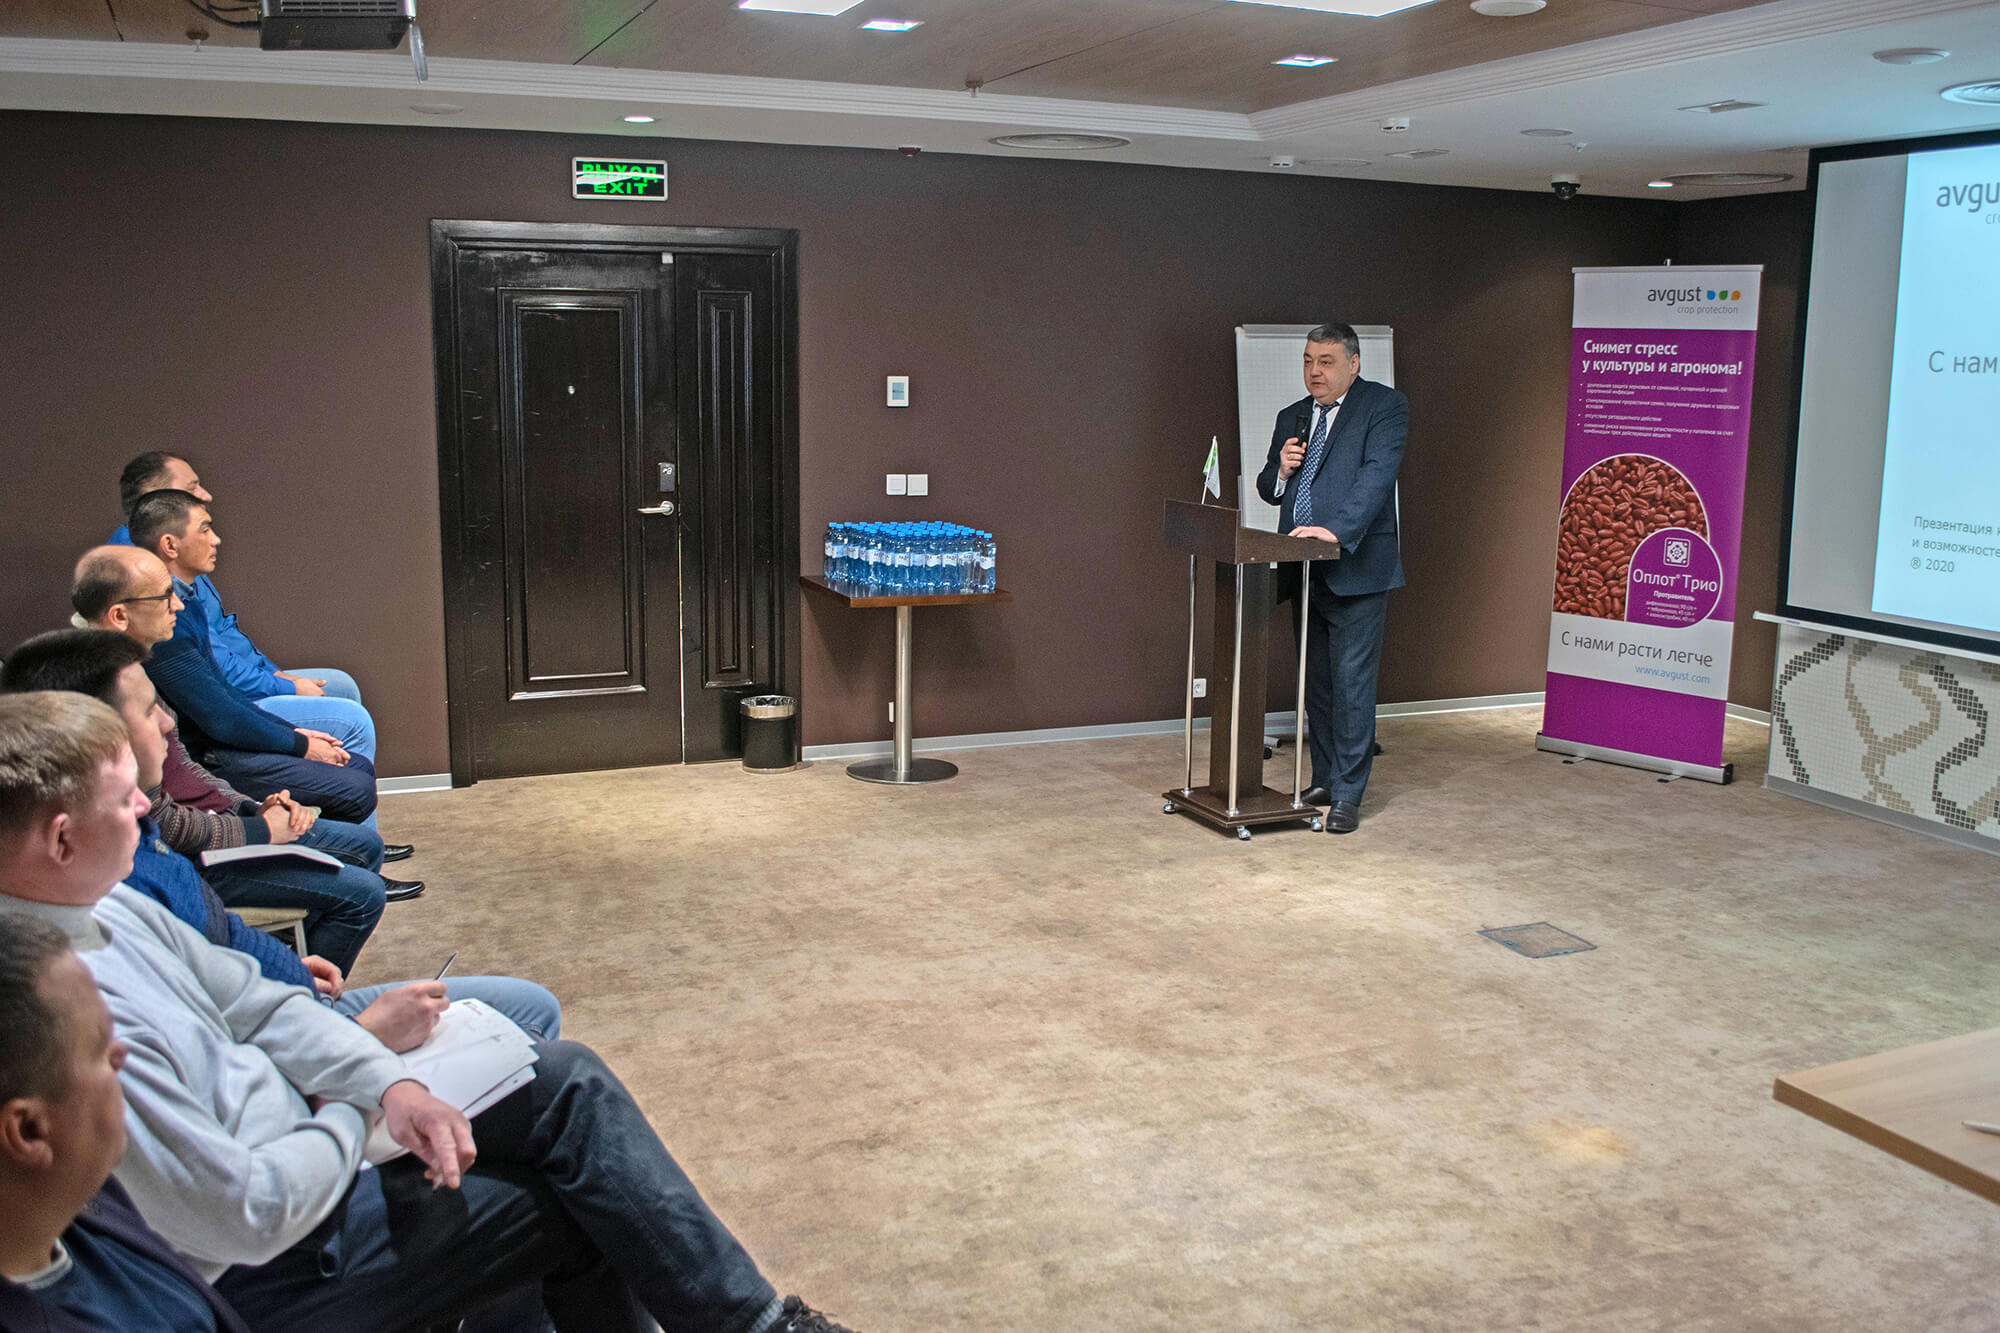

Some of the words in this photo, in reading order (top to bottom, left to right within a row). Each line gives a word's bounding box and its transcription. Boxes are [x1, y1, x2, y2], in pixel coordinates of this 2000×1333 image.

[593, 181, 648, 195] EXIT
[1936, 182, 2000, 213] avgu
[1647, 286, 1701, 306] avgust
[1677, 306, 1694, 314] crop
[1696, 305, 1738, 314] protection
[1583, 340, 1632, 355] Снимет
[1635, 343, 1678, 357] стресс
[1582, 361, 1590, 374] у
[1593, 361, 1654, 375] культуры
[1658, 362, 1667, 372] и
[1670, 361, 1742, 376] агронома!
[1914, 515, 1992, 535] Презентация
[1912, 539, 1919, 548] и
[1925, 558, 1955, 573] 2020
[1682, 574, 1717, 592] Трио
[1561, 631, 1570, 646] С
[1574, 635, 1614, 652] нами
[1618, 641, 1662, 660] расти
[1666, 649, 1713, 667] легче
[1634, 664, 1710, 684] www.avgust.com
